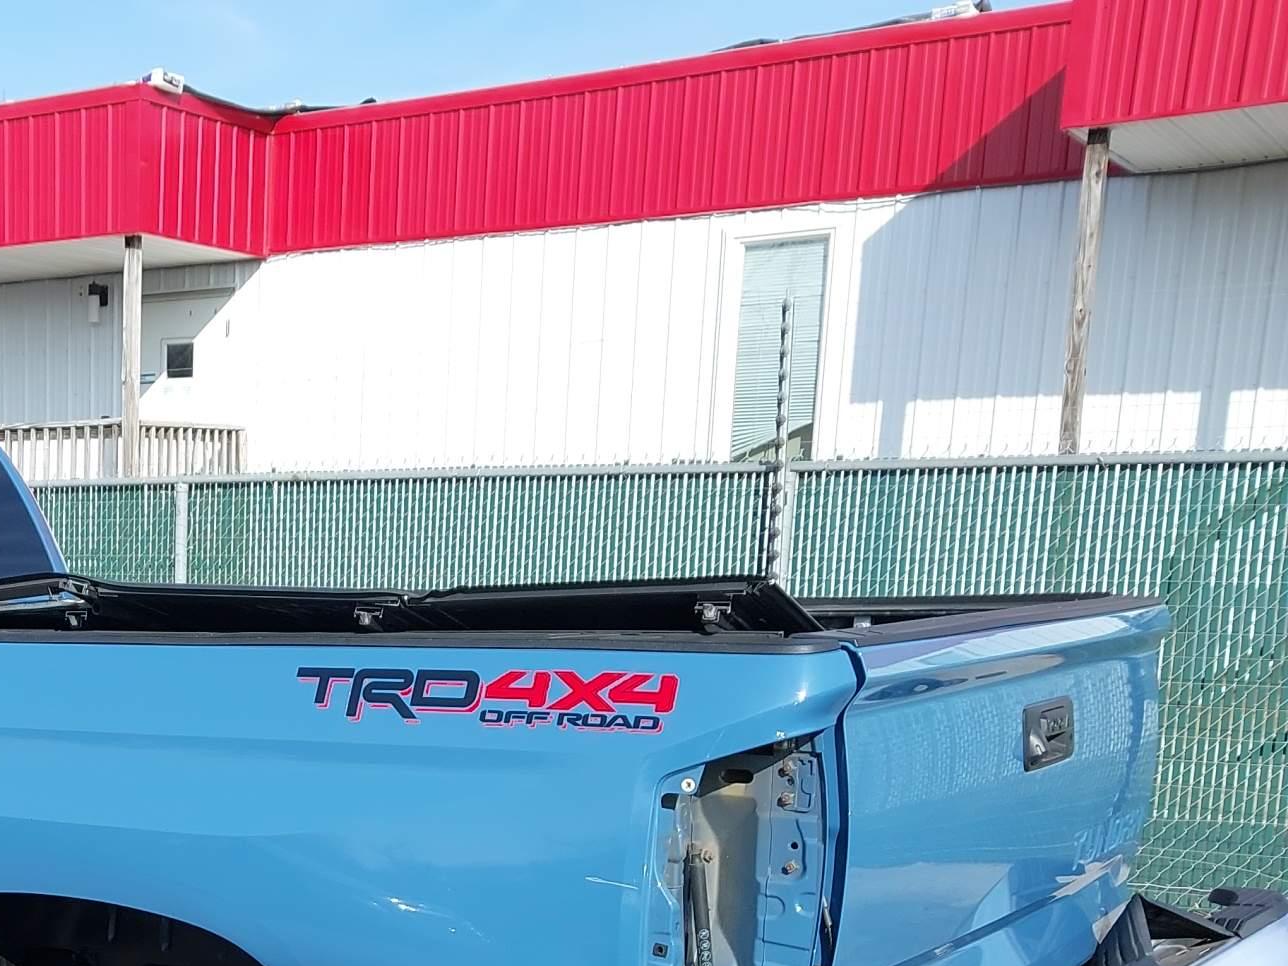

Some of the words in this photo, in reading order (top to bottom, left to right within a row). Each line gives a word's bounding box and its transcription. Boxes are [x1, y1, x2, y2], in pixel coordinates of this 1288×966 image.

[296, 666, 481, 722] TRD
[478, 708, 552, 730] OFF
[555, 711, 664, 734] ROAD
